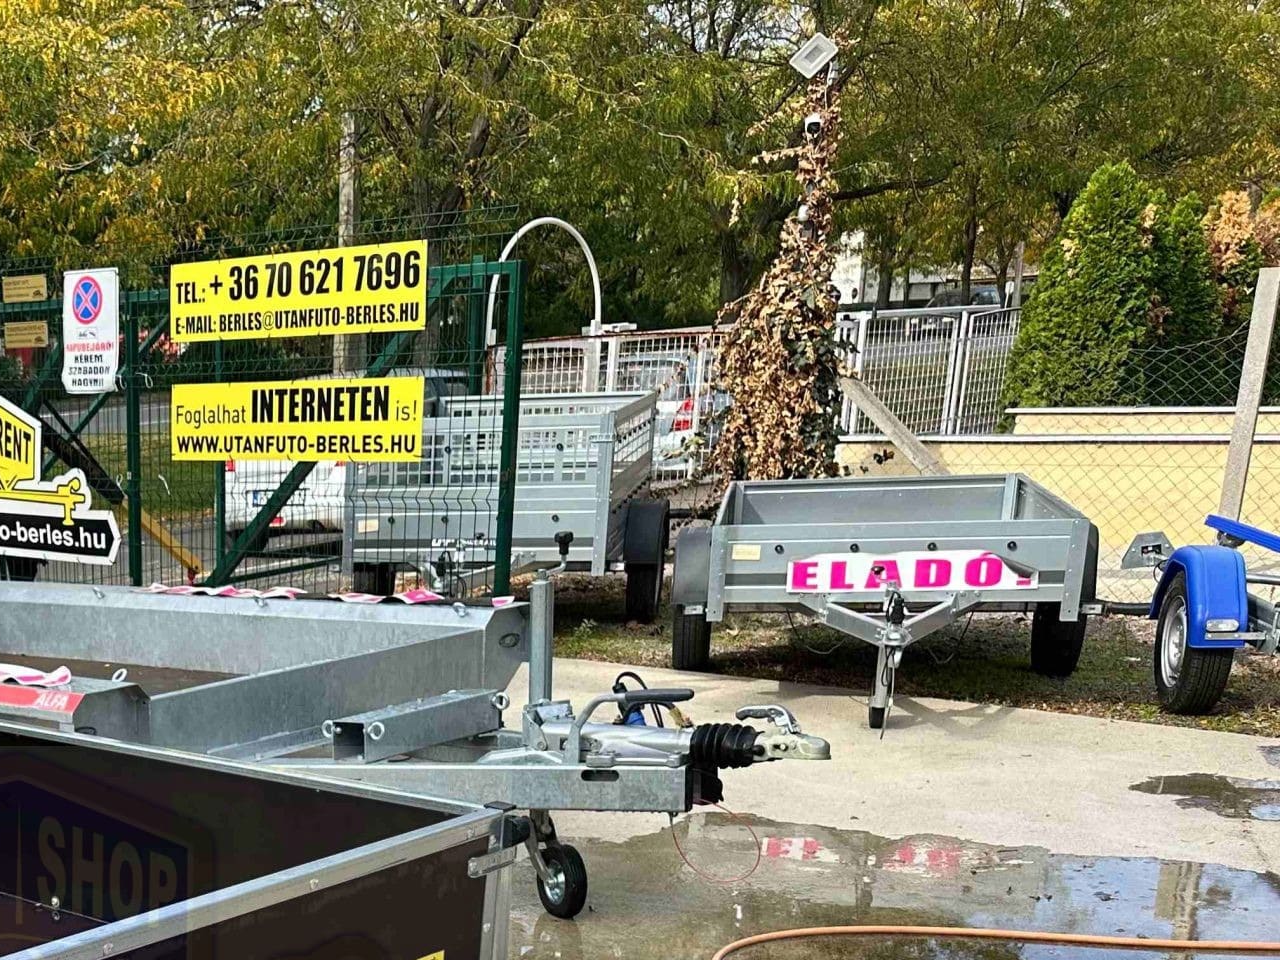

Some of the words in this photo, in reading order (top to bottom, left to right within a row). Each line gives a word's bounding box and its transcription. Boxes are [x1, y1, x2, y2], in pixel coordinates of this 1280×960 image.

[176, 283, 206, 304] TEL.:
[229, 265, 259, 301] 36
[265, 262, 292, 298] 70
[299, 256, 344, 296] 621
[353, 250, 421, 292] 7696
[176, 315, 217, 335] E-MAIL:
[219, 302, 420, 332] BERLES@UTANFUTO-BERLES.HU
[176, 404, 246, 429] Foglalhat
[251, 385, 390, 423] INTERNETEN
[395, 400, 417, 421] is!
[177, 434, 416, 453] WWW.UTANFUTO-BERLES.HU
